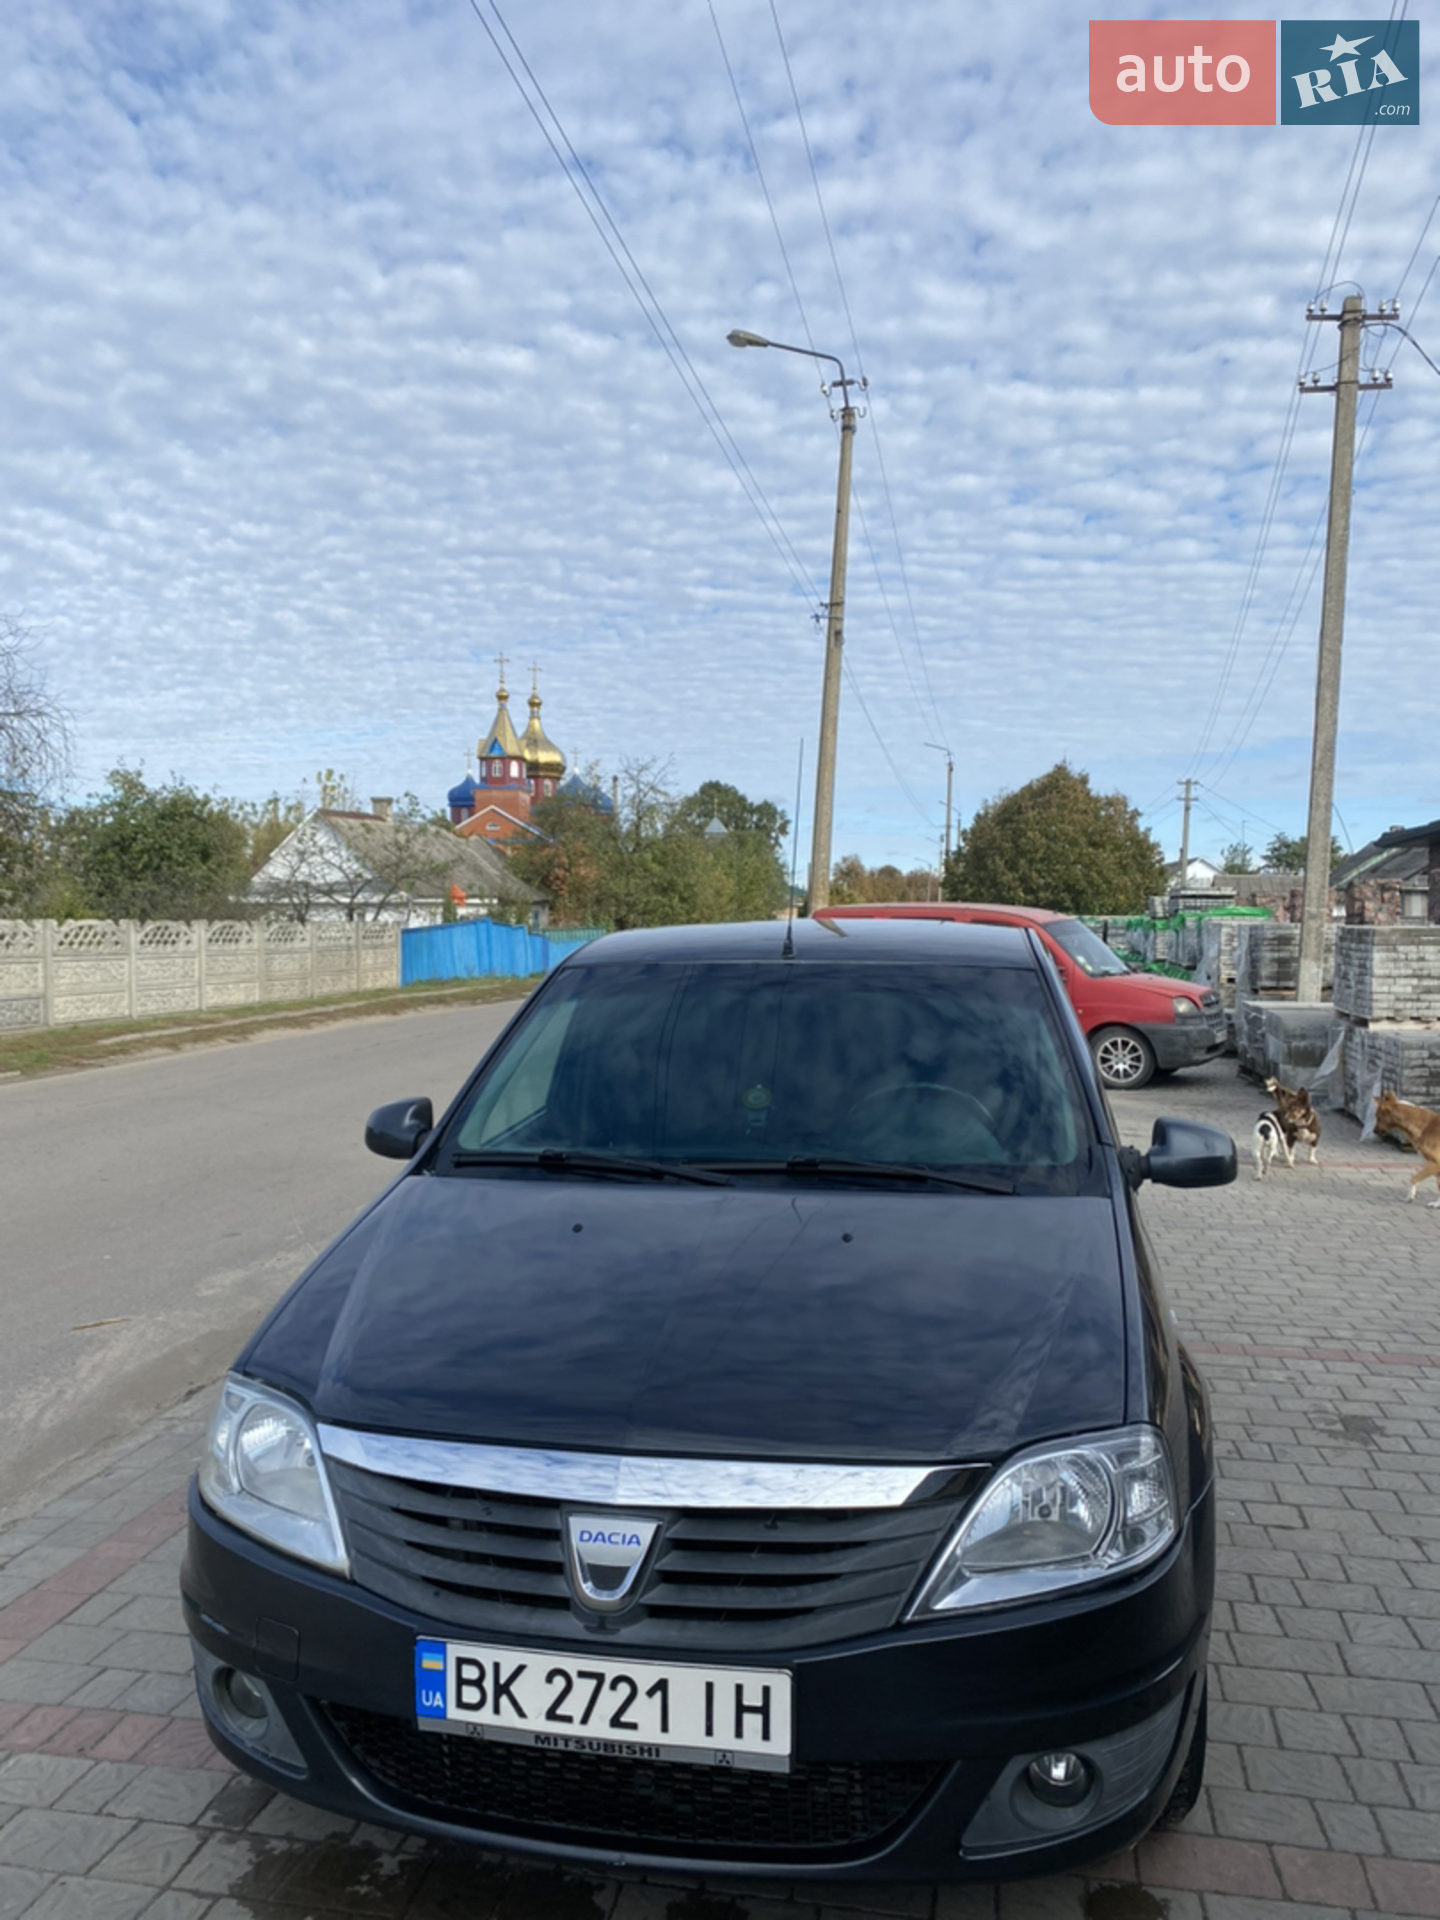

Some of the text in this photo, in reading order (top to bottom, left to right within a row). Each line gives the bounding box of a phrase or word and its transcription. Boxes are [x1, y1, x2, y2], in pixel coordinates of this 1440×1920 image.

[578, 1529, 642, 1547] DACIA
[421, 1689, 444, 1709] UA
[454, 1655, 771, 1742] BK 2721 IH
[533, 1733, 661, 1759] MITSUBISHI
